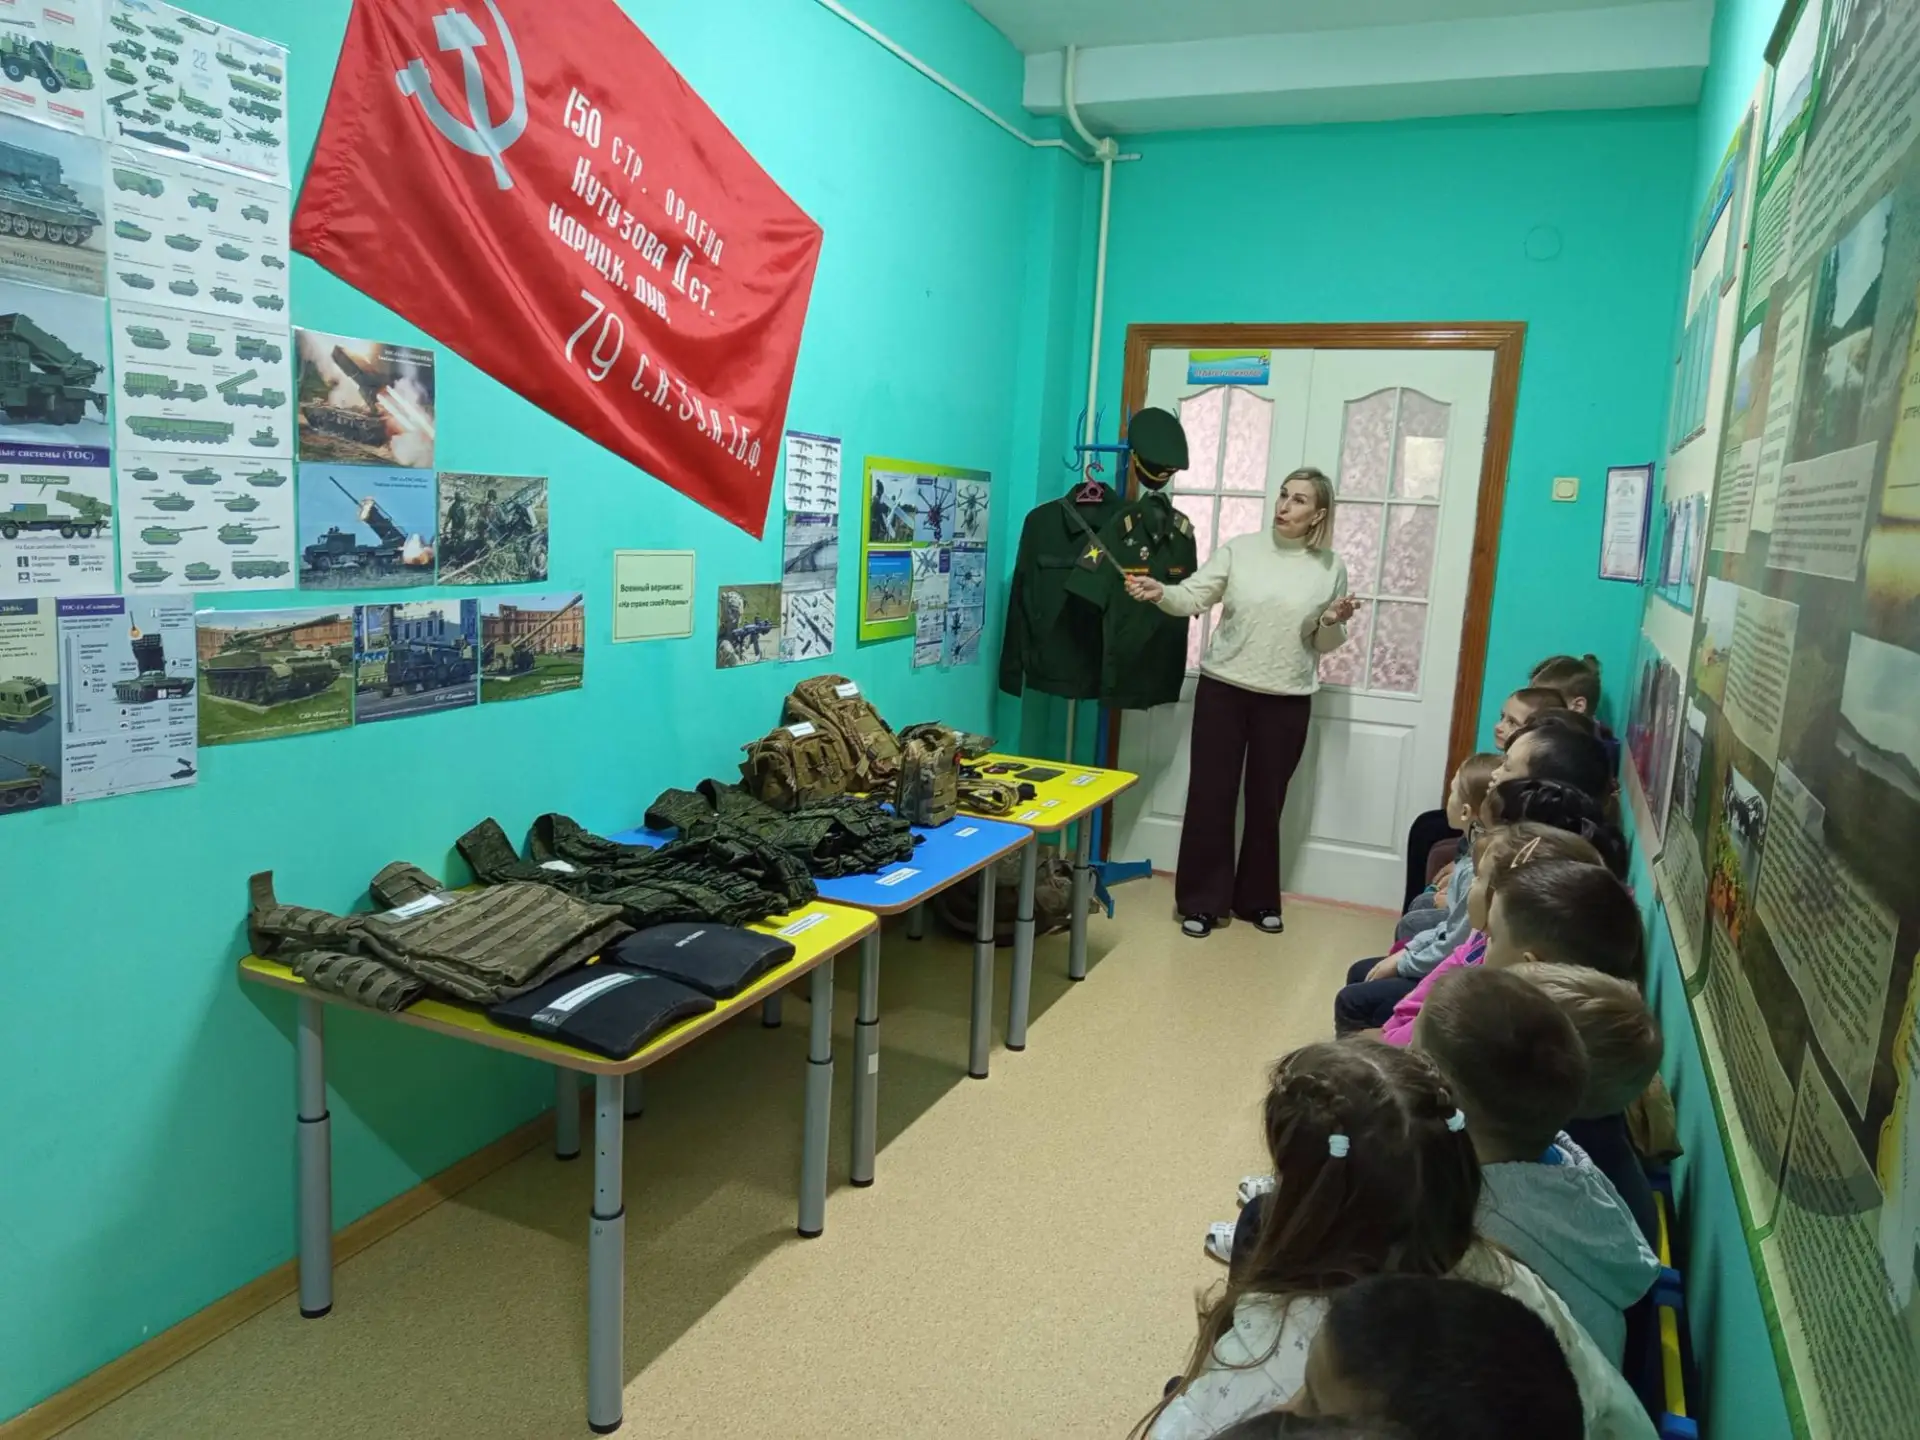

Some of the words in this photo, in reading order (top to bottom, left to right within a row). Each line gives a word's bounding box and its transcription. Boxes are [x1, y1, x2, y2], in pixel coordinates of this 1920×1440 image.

[563, 86, 602, 148] 150
[665, 188, 724, 266] ОРДЕНА
[548, 202, 629, 291] ИДРИЦК.
[633, 274, 672, 324] ДИВ.
[565, 289, 624, 382] 79
[62, 450, 95, 461] (ТОС)
